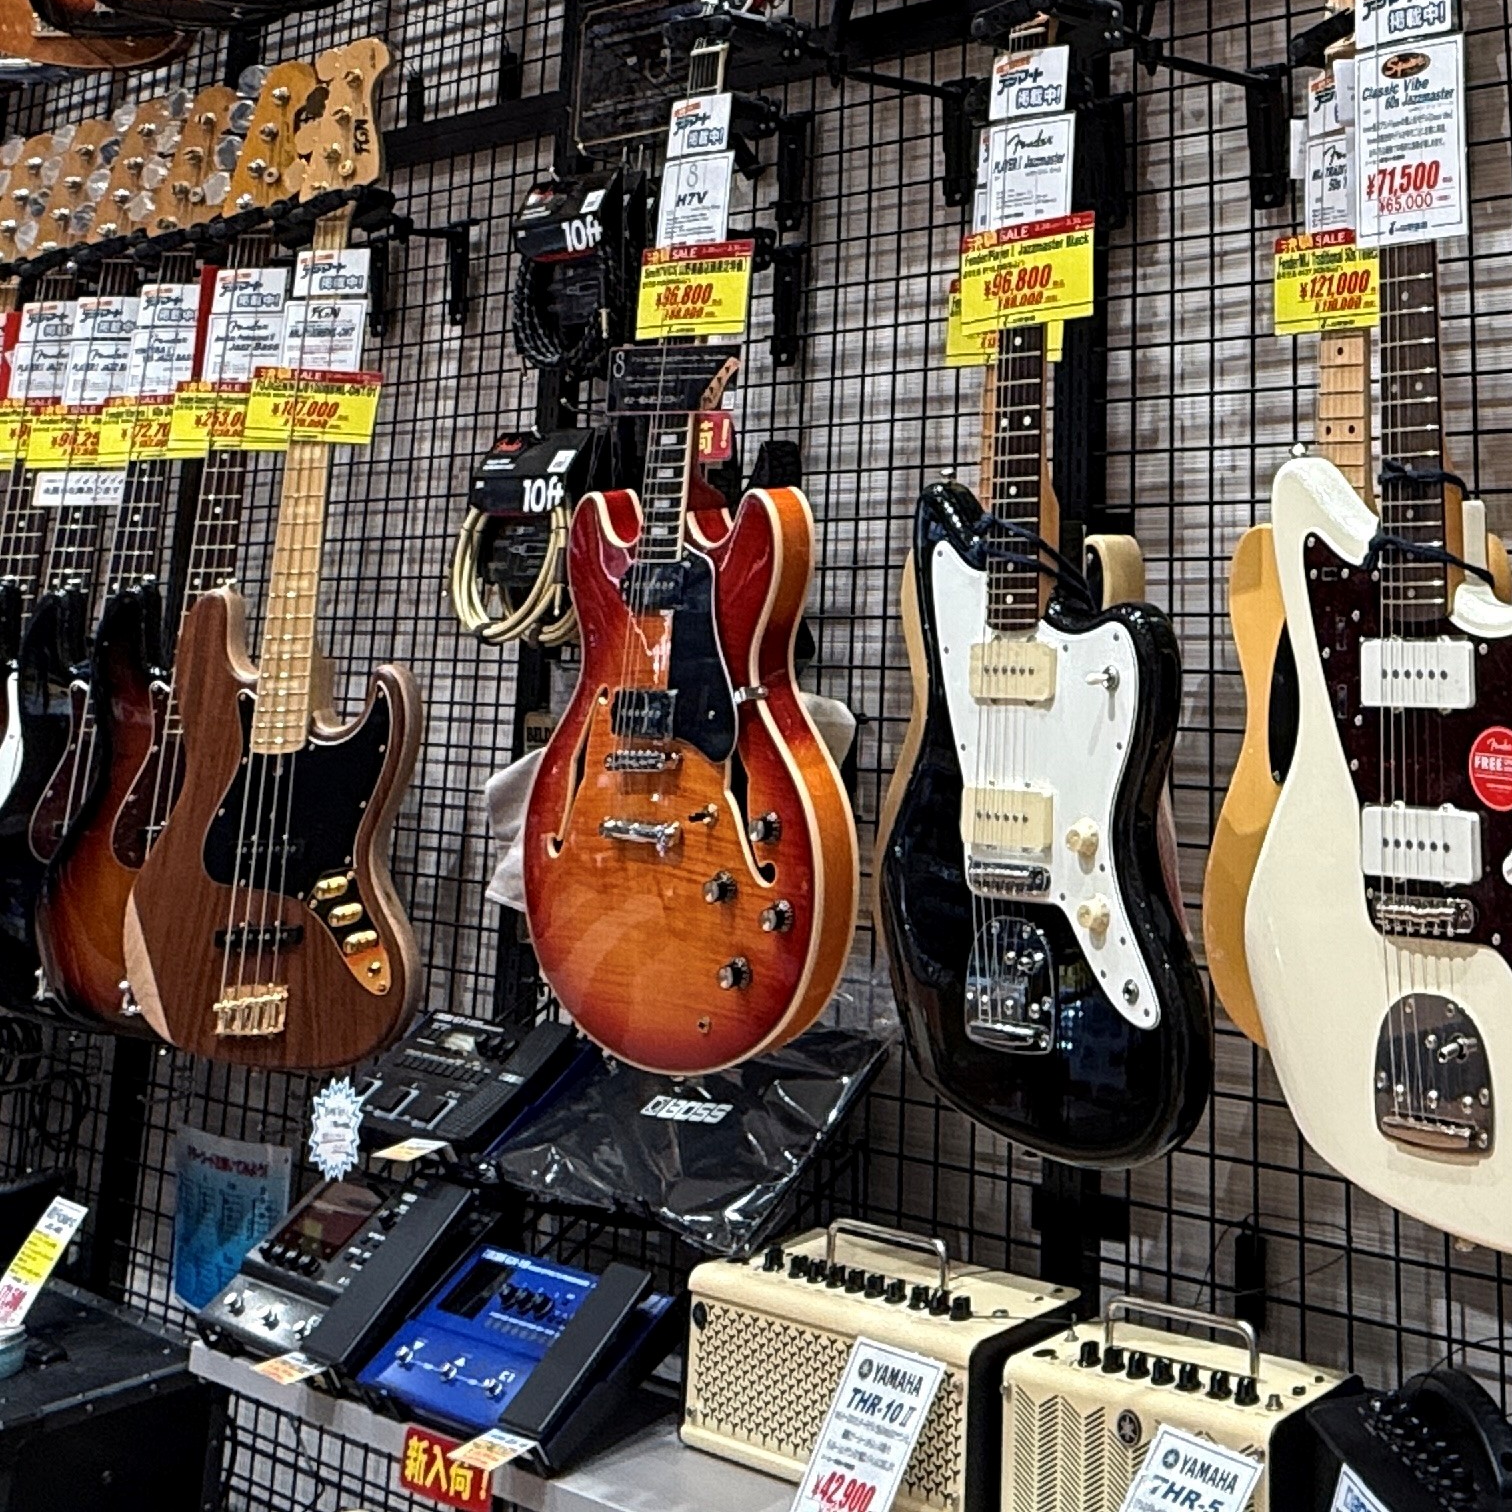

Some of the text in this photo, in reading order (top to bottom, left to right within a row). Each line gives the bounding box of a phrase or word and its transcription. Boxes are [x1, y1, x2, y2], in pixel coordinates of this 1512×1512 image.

[1361, 75, 1430, 103] Classic Vibe
[1006, 129, 1055, 156] Fender
[1366, 160, 1441, 202] ¥71,500
[676, 190, 708, 208] H7V
[1377, 193, 1434, 214] ¥65,000
[1000, 225, 1030, 243] SALE
[672, 246, 698, 260] SALE
[984, 264, 1053, 299] ¥96,800
[1299, 268, 1371, 301] ¥121,000
[522, 476, 564, 513] 10ft
[1474, 755, 1504, 771] FREE
[662, 1099, 736, 1125] BOSS
[872, 1362, 924, 1397] YAMAHA
[1179, 1453, 1240, 1495] YAMAHA
